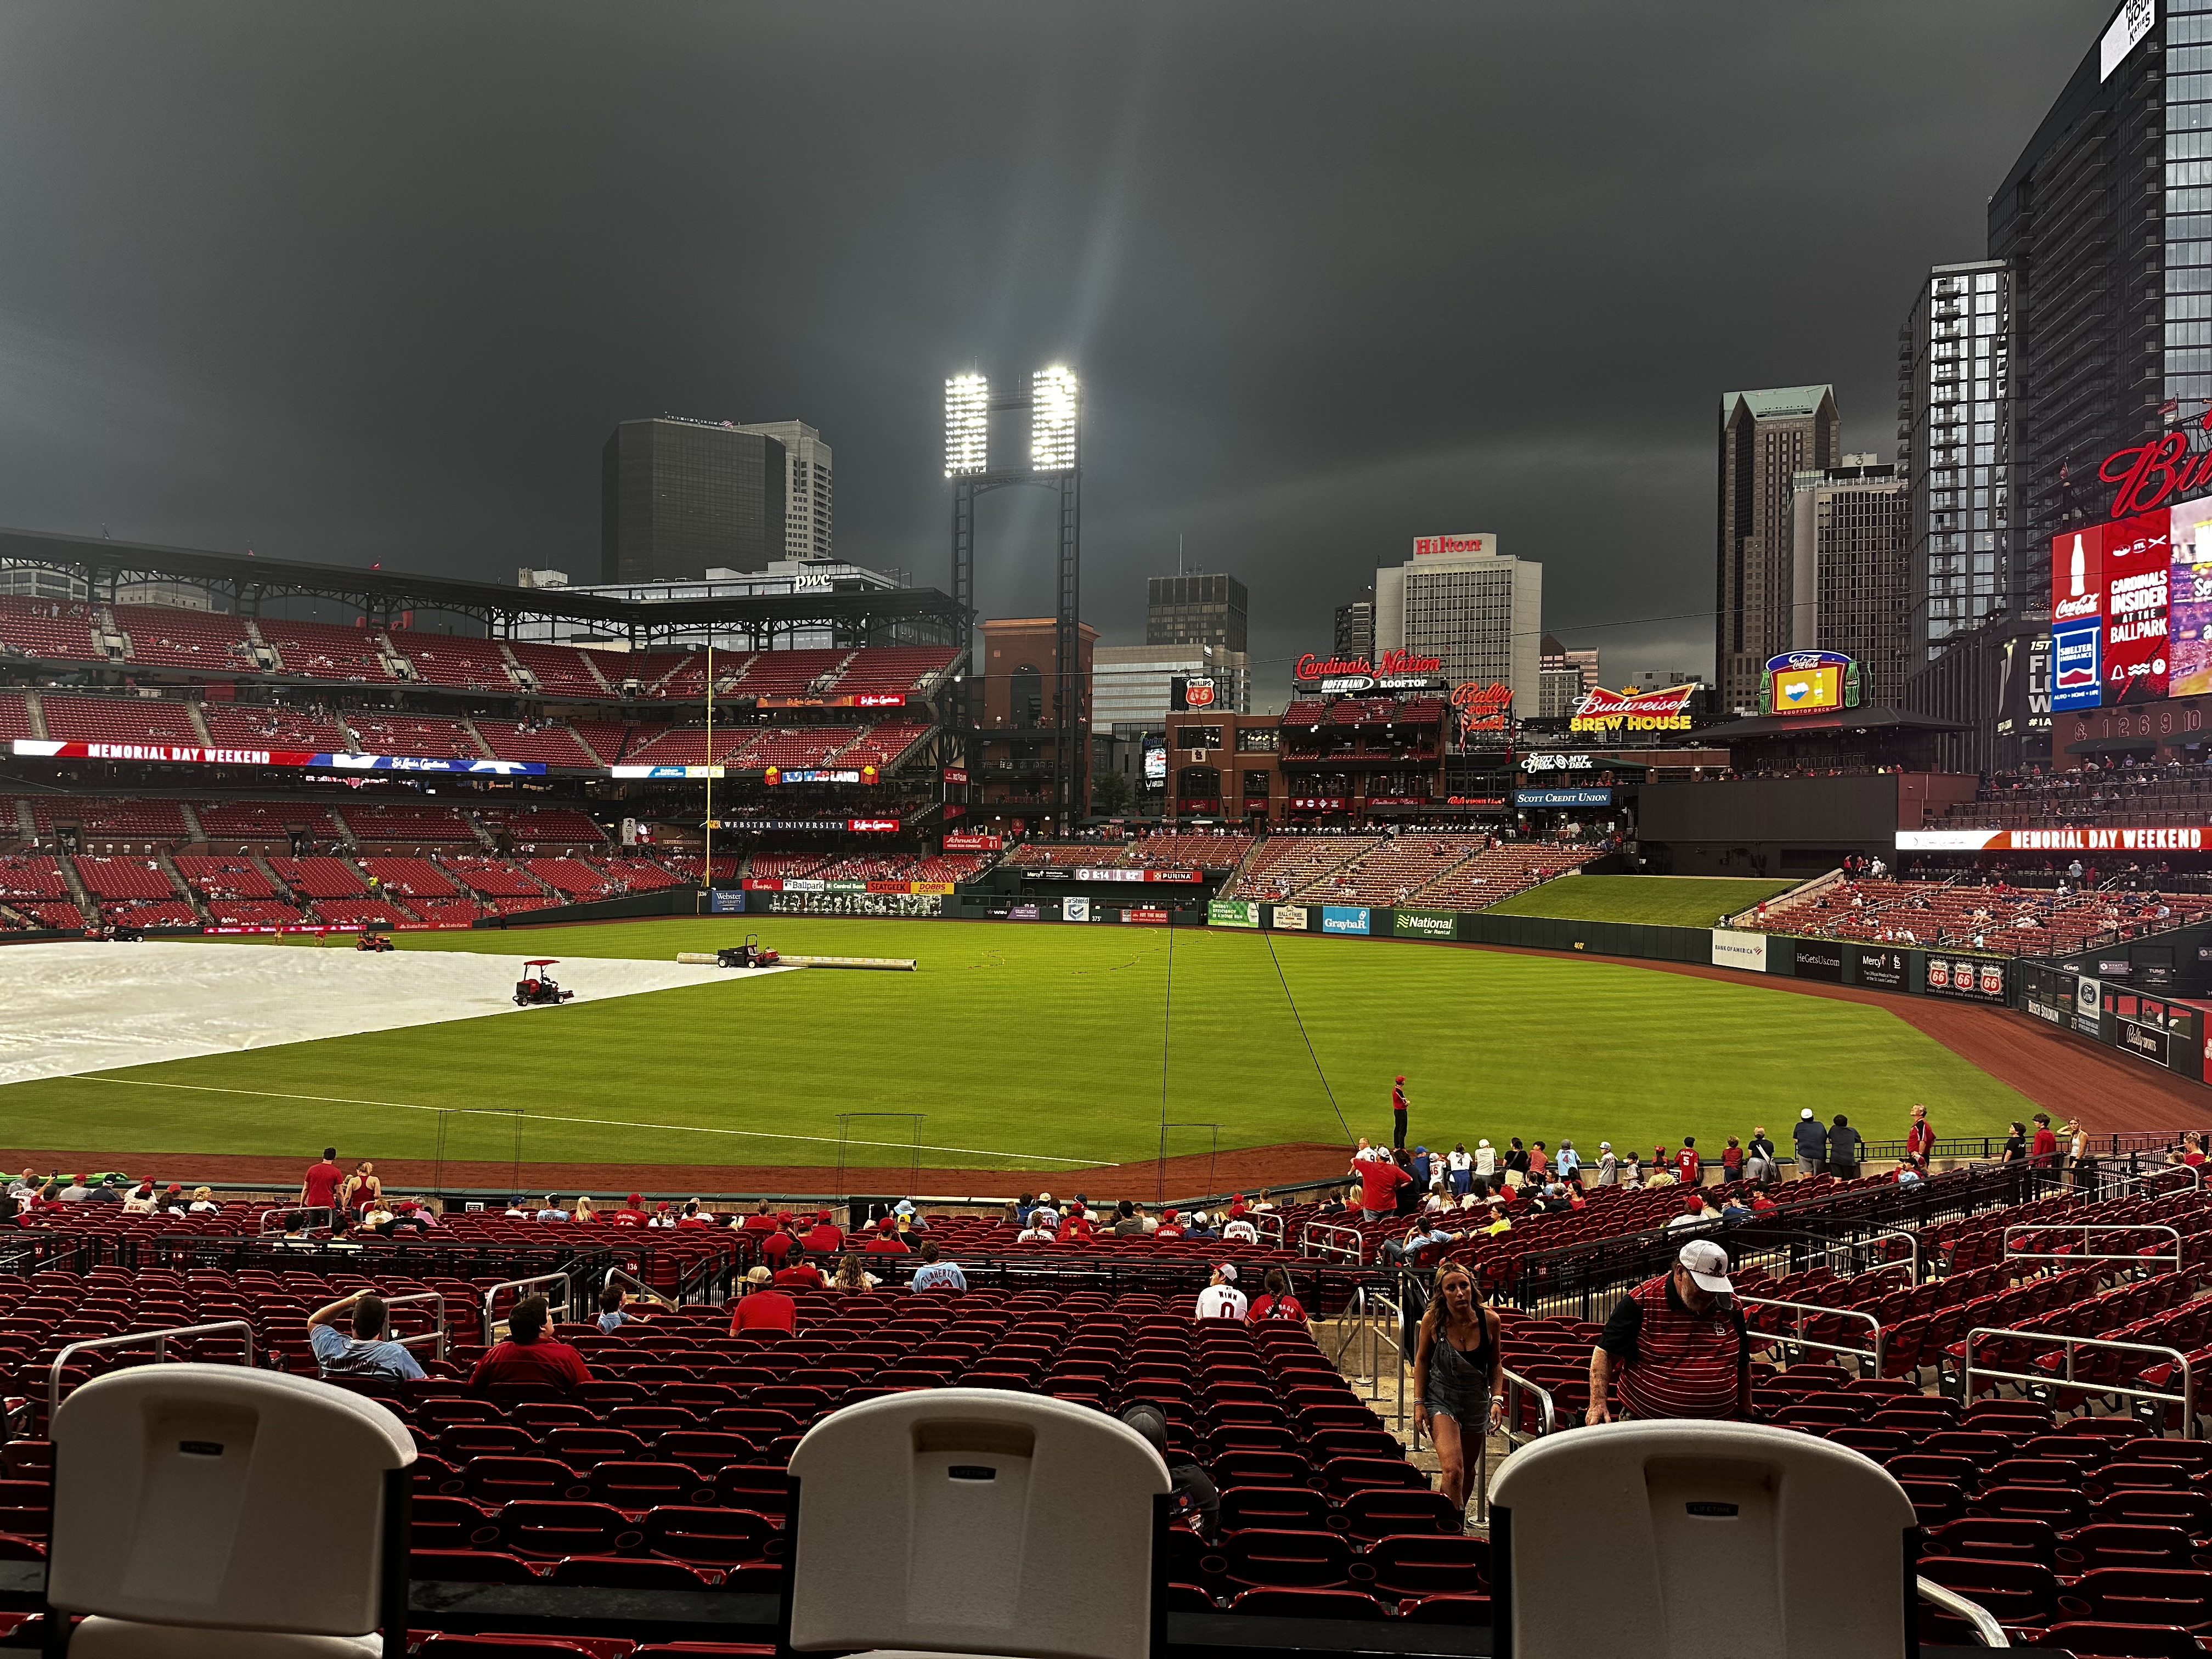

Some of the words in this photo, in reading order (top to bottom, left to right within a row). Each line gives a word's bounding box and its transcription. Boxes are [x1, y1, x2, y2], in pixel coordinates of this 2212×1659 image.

[1416, 536, 1481, 554] Hilton
[794, 574, 832, 591] pwc
[2111, 570, 2167, 595] CARDINALS
[2056, 592, 2100, 618] Coca-Cola
[2111, 585, 2167, 614] INSIDER
[2122, 613, 2134, 623] AT
[2138, 608, 2155, 620] THE
[2111, 618, 2167, 643] BALLPARK
[2030, 641, 2052, 651] 1ST
[2060, 644, 2092, 656] SHELTER
[2060, 652, 2092, 662] INSURANCE
[1296, 653, 1372, 680] Cardinals
[1372, 649, 1440, 678] Nation
[1322, 679, 1365, 690] HOFFMANN
[1380, 679, 1427, 688] ROOFTOP
[1190, 689, 1209, 701] 66
[1451, 682, 1515, 709] Bally
[1572, 696, 1691, 714] Budweiser
[1571, 716, 1623, 731] BREW
[1628, 715, 1691, 730] HOUSE
[2103, 719, 2108, 738] 1
[2119, 718, 2129, 737] 2
[2139, 715, 2149, 735] 6
[2160, 713, 2171, 733] 9
[2183, 710, 2201, 731] 10
[88, 744, 167, 760] MEMORIAL
[172, 748, 200, 761] DAY
[204, 749, 270, 764] WEEKEND
[804, 771, 829, 782] MAC
[830, 771, 859, 783] LAND
[1517, 794, 1544, 803] SCOTT
[1545, 793, 1577, 802] CREDIT
[1578, 793, 1607, 802] UNION
[2011, 830, 2084, 849] MEMORIAL
[2089, 830, 2117, 848] DAY
[2123, 829, 2201, 848] WEEKEND
[793, 881, 823, 891] Ballpark
[871, 883, 906, 891] SEATGEEK
[1409, 916, 1453, 929] National
[1797, 952, 1839, 967] HeGetsUs.com
[1863, 955, 1882, 968] Mercy
[1932, 971, 1944, 981] 66
[1957, 974, 1970, 985] 66
[1984, 978, 1997, 989] 66
[2041, 1004, 2059, 1023] STADIUM
[2126, 1024, 2144, 1052] Bally
[2143, 1037, 2157, 1052] SPORTS
[1370, 1154, 1375, 1163] 9
[1458, 1158, 1463, 1166] 4
[1562, 1154, 1569, 1164] 4
[1683, 1156, 1690, 1166] 5
[922, 1269, 957, 1284] FLAHERTY
